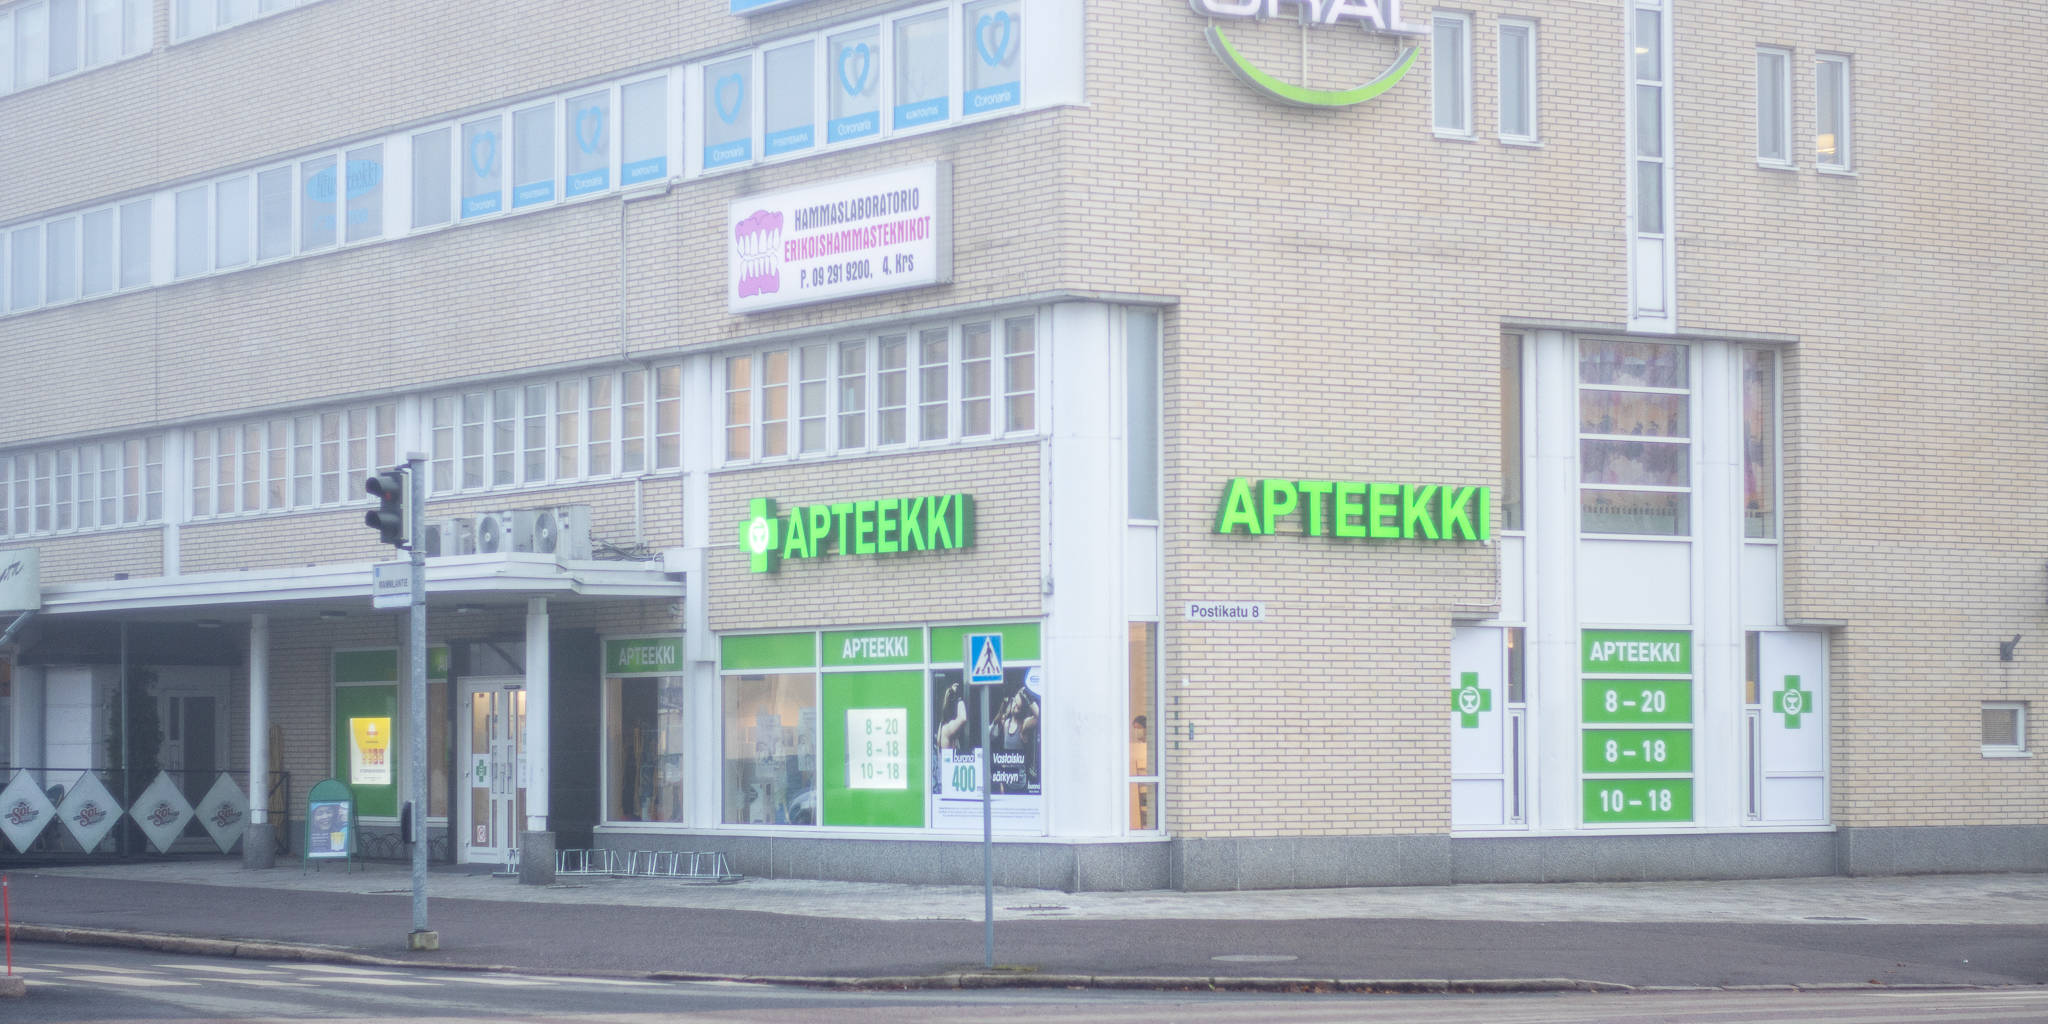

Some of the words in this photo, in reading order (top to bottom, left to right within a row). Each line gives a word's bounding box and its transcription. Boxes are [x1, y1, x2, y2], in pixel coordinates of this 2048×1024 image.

[1190, 0, 1432, 35] AL
[794, 187, 920, 232] HAMMASLABORATORIO
[784, 216, 931, 263] ERIKOISHAMMASTEKNIKOT
[800, 269, 810, 289] P.
[812, 266, 824, 287] 09
[827, 263, 843, 285] 291
[882, 255, 892, 275] 4.
[895, 253, 914, 274] Krs
[1216, 477, 1491, 540] APTEEKKI
[783, 493, 969, 560] APTEEKKI
[1191, 605, 1248, 618] Postikatu
[1250, 606, 1260, 618] 8
[618, 645, 675, 667] APTEEKKI
[842, 636, 909, 659] APTEEKKI
[1589, 641, 1680, 662] APTEEKKI
[1605, 690, 1618, 713] 8
[1641, 690, 1666, 713] 20
[866, 719, 873, 735] 8
[885, 718, 899, 735] 20
[866, 741, 873, 757] 8
[886, 740, 899, 757] 18
[992, 752, 1025, 765] Vastaisku
[1605, 739, 1618, 763] 8
[1642, 739, 1666, 763] 18
[860, 763, 873, 779] 10
[886, 763, 900, 779] 18
[952, 765, 976, 792] 400
[1600, 789, 1624, 813] 10
[1648, 789, 1672, 812] 18
